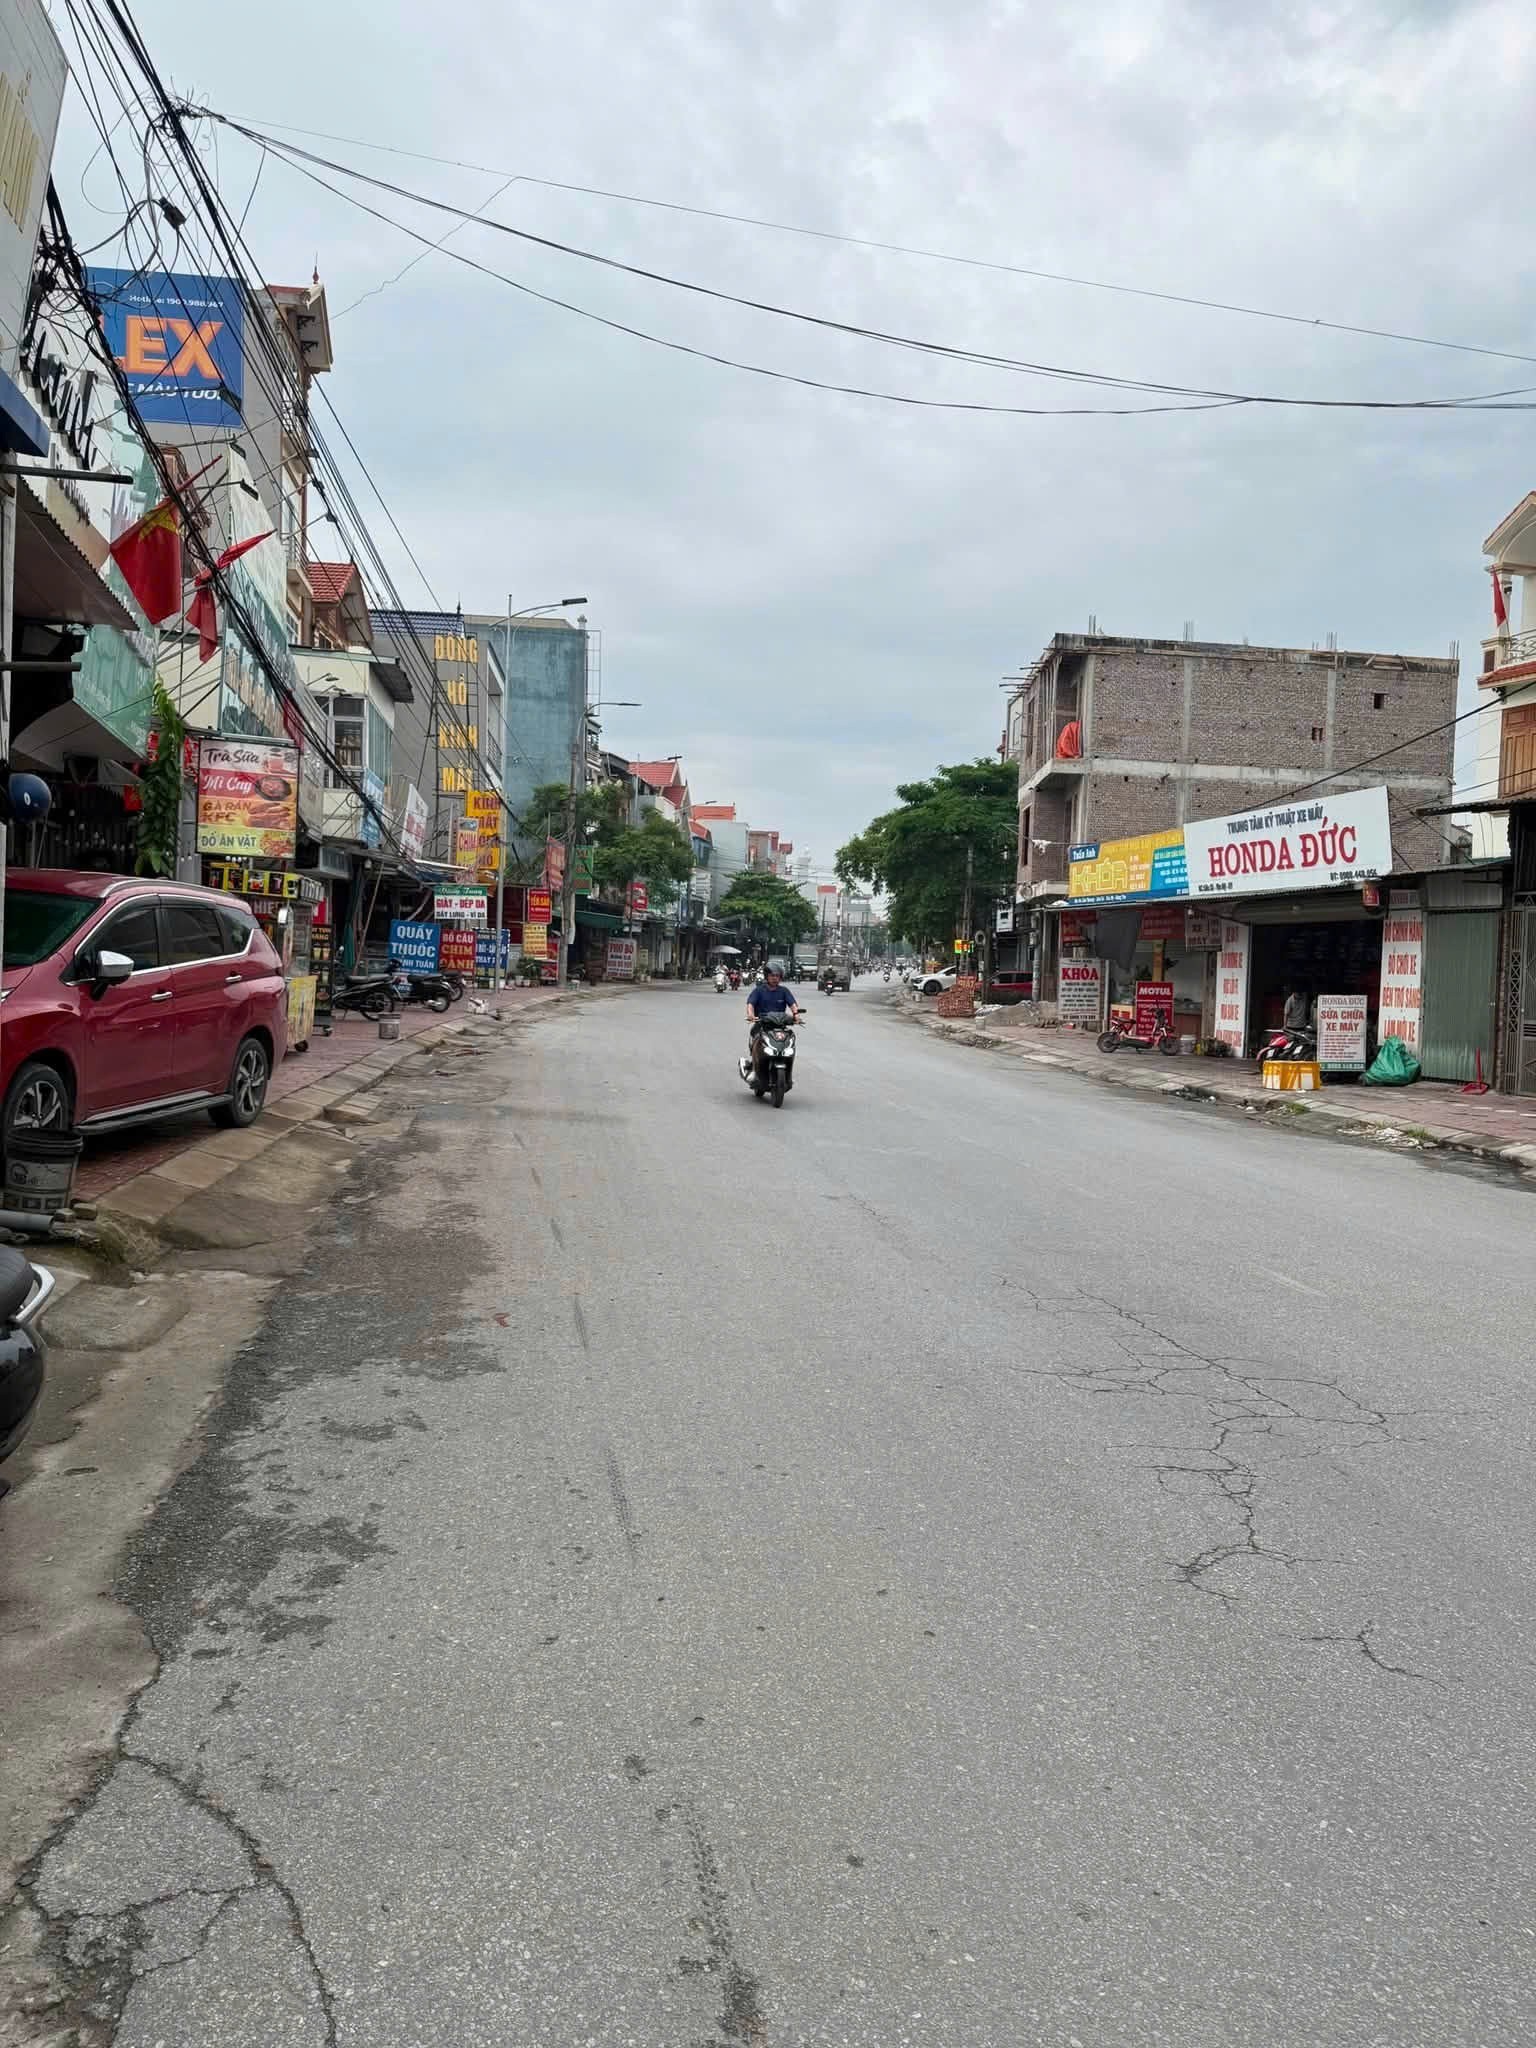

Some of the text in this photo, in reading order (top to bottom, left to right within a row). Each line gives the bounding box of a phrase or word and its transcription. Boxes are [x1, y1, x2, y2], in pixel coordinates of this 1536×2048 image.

[203, 747, 260, 764] Trà Sữa
[203, 775, 253, 794] Mì Cay
[1227, 819, 1249, 834] TRUNG
[1248, 815, 1264, 830] TÂM
[1296, 809, 1307, 823] XE
[1307, 803, 1324, 820] MÁY
[201, 830, 217, 847] ĐỒ
[1208, 837, 1295, 877] HONDA
[1299, 816, 1357, 867] ĐỨC
[391, 941, 436, 958] THUỐC
[441, 944, 473, 956] CHIM
[1410, 954, 1417, 975] XE
[1138, 986, 1171, 996] MOTUL
[1321, 997, 1349, 1006] HONDA
[1320, 1007, 1365, 1020] SỬA CHỮA
[1326, 1022, 1337, 1031] XE
